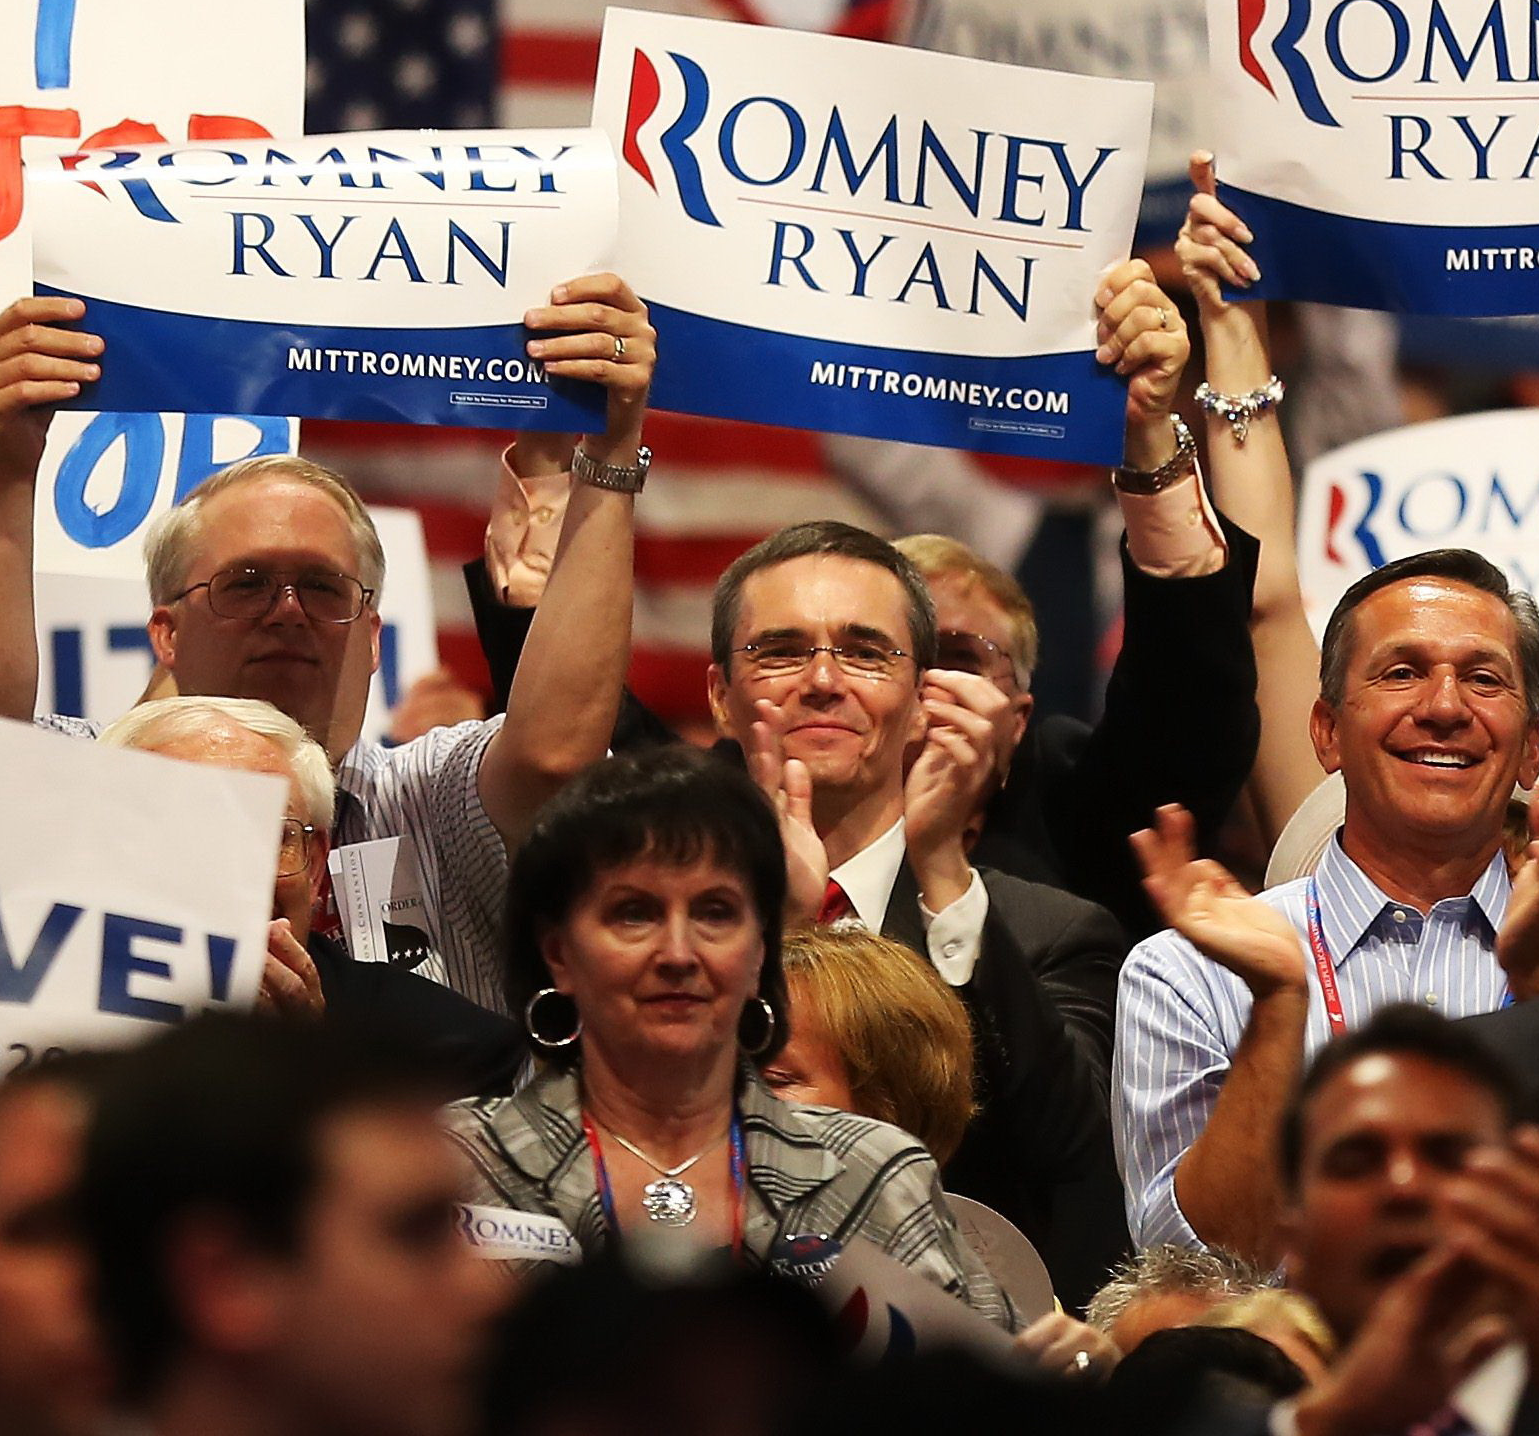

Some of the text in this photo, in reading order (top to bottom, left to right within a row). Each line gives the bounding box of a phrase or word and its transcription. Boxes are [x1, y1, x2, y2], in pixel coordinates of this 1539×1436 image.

[622, 45, 1120, 233] ROMNEY
[58, 145, 575, 225] ROMNEY
[225, 211, 517, 289] RYAN
[766, 220, 1039, 323] RYAN
[287, 346, 550, 384] MITTROMNEY.COM
[810, 360, 1070, 416] MITTROMNEY.COM
[460, 1206, 574, 1247] ROMNEY
